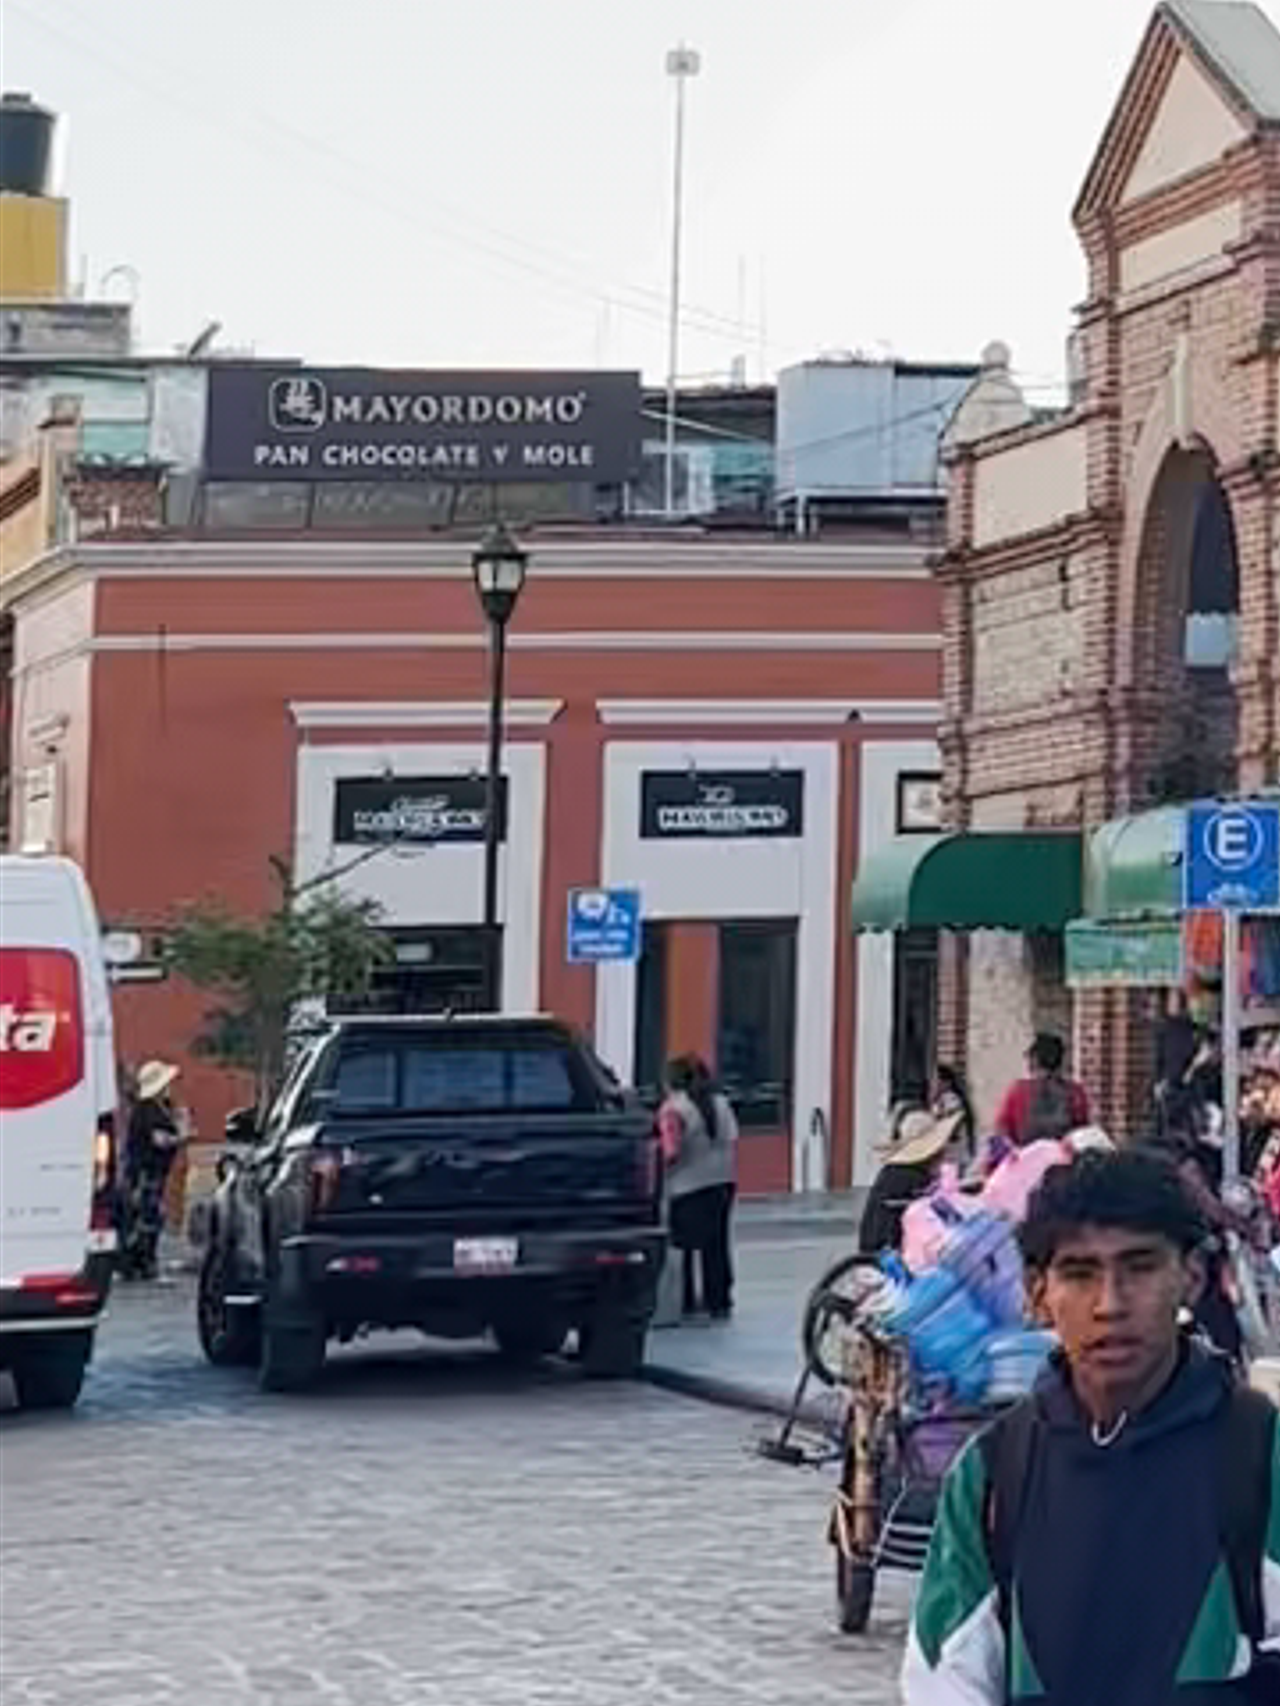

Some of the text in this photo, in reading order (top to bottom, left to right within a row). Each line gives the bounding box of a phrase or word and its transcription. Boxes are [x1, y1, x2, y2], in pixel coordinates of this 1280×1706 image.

[333, 395, 583, 423] MAYORDOMO
[254, 444, 594, 466] PAN CHOCOLATE Y MOLE
[1217, 819, 1247, 859] E
